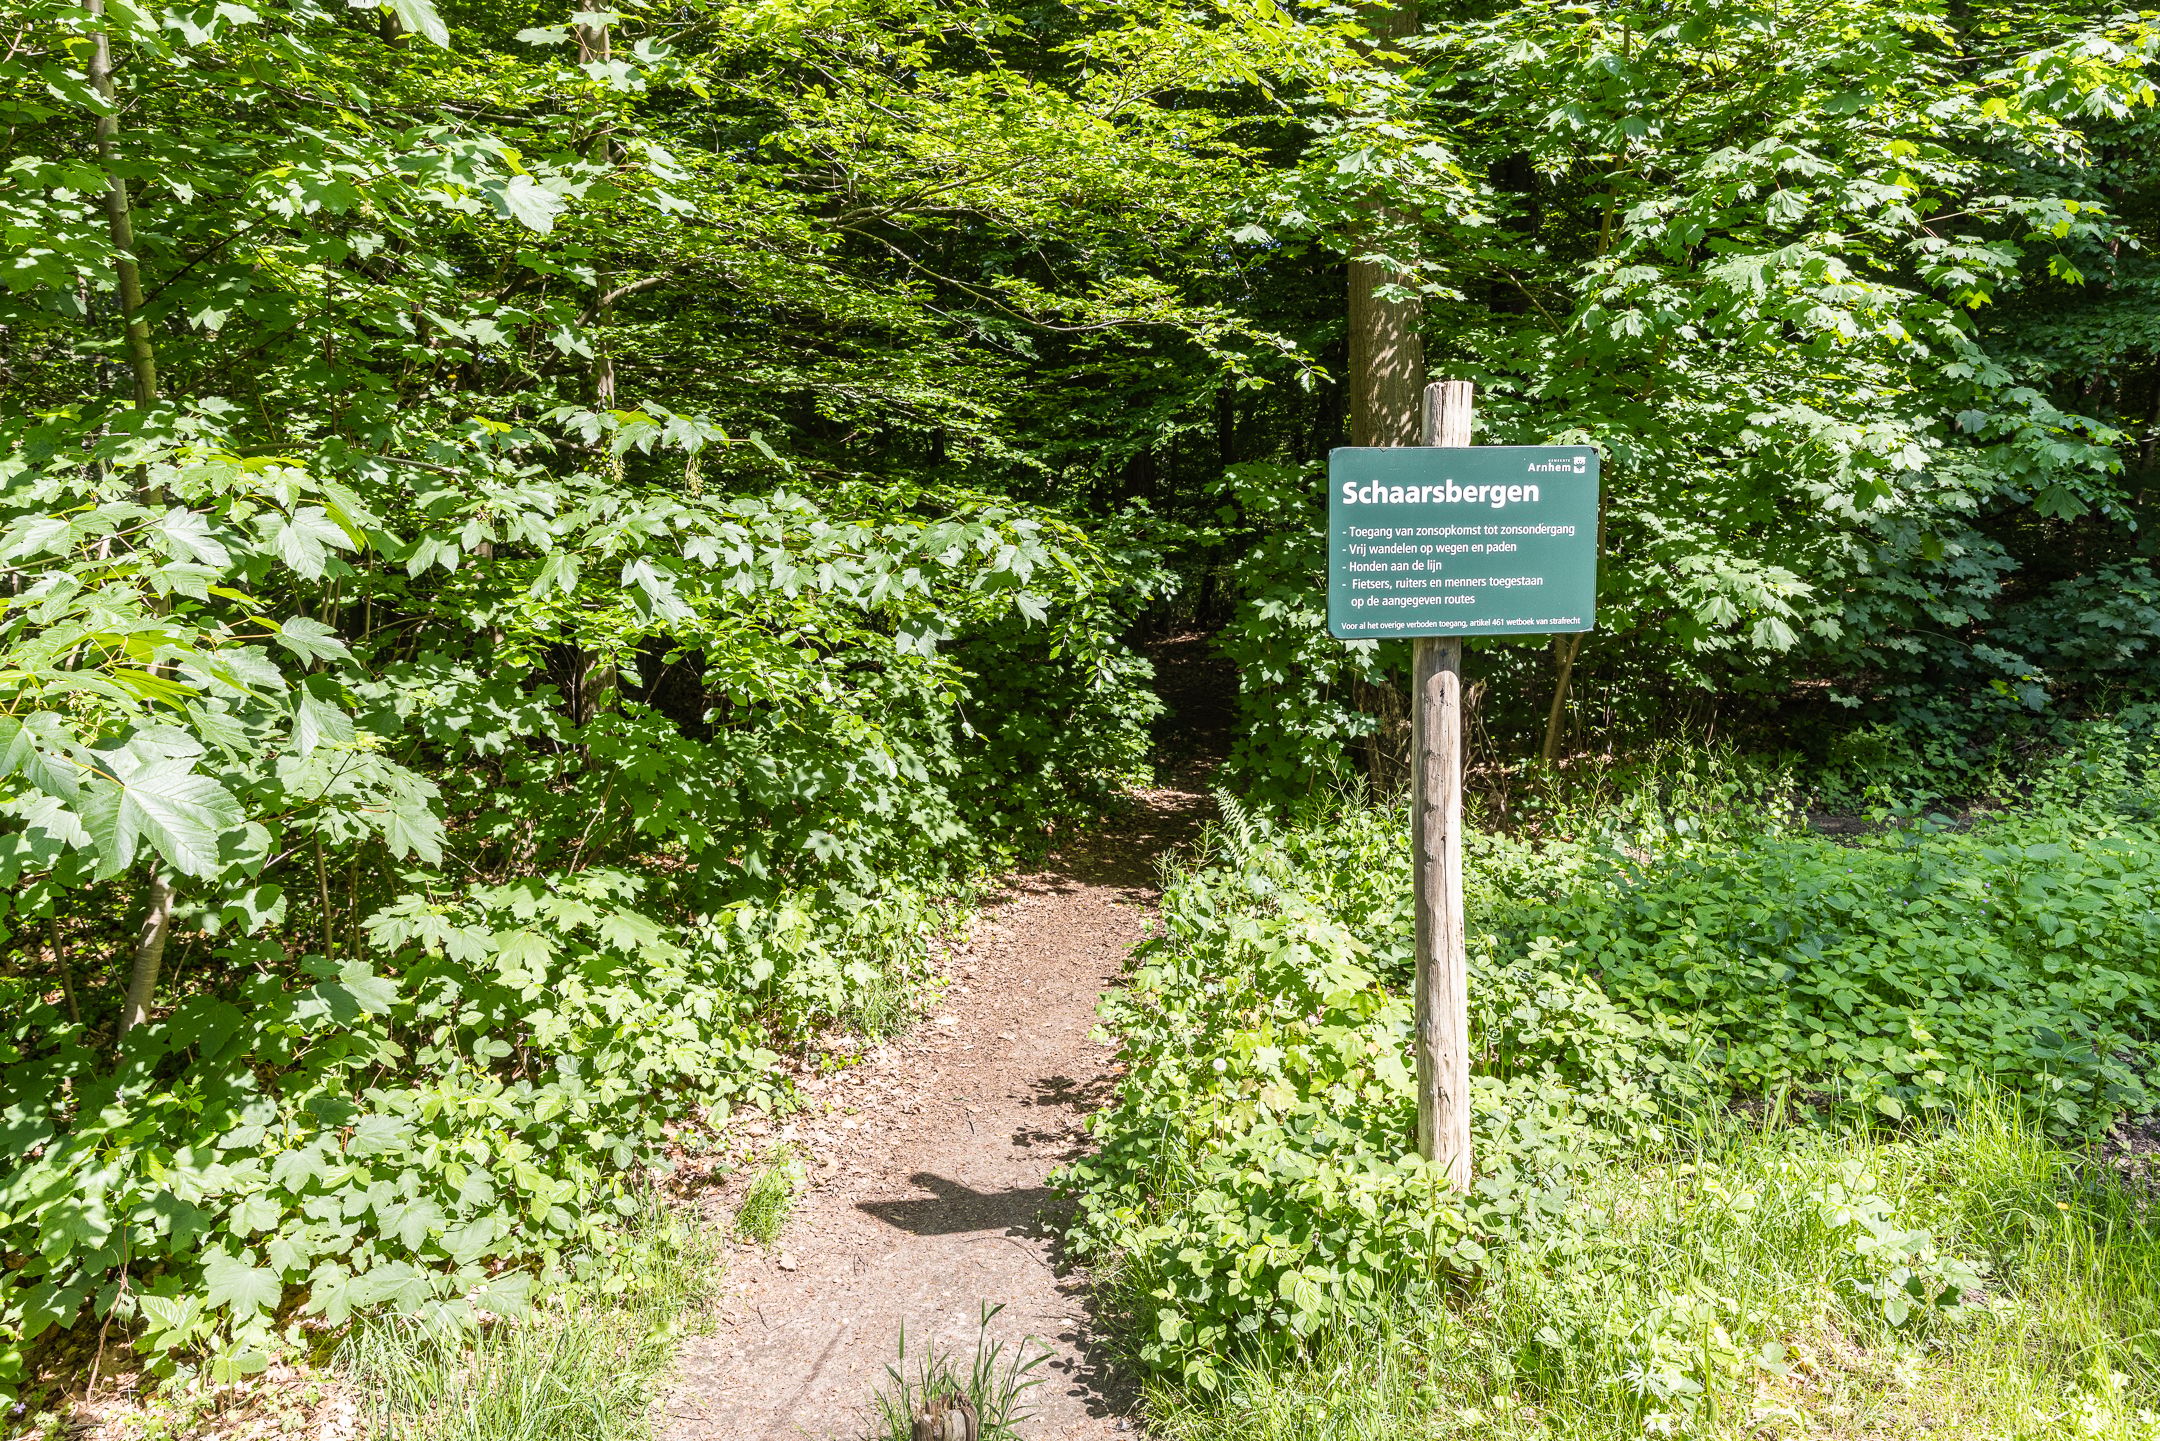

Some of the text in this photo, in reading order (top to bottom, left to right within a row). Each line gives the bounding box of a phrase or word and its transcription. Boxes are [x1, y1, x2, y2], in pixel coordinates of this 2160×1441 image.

[1528, 462, 1571, 471] Arnhem
[1343, 479, 1539, 508] Schaarsbergen
[1349, 527, 1392, 539] Toegang
[1395, 528, 1413, 536] van
[1416, 524, 1481, 538] zonsopkomst
[1484, 524, 1498, 535] tot
[1500, 522, 1576, 536] zonsondergang
[1349, 544, 1366, 557] Vrij
[1369, 543, 1417, 554] wandelen
[1420, 545, 1433, 555] op
[1436, 544, 1468, 555] wegen
[1471, 544, 1483, 552] en
[1486, 541, 1517, 553] paden
[1350, 561, 1387, 572] Honden
[1391, 563, 1409, 571] aan
[1412, 560, 1424, 570] de
[1427, 559, 1442, 573] lijn
[1353, 579, 1392, 589] Fietsers,
[1396, 578, 1427, 588] ruiters
[1430, 579, 1441, 587] en
[1445, 579, 1486, 587] menners
[1489, 576, 1543, 588] toegestaan
[1351, 595, 1475, 608] op de aangegeven routes
[1359, 622, 1365, 630] al
[1367, 622, 1378, 630] het
[1380, 621, 1405, 631] overige
[1406, 620, 1437, 629] verboden
[1439, 621, 1468, 630] toegang,
[1470, 619, 1490, 627] artikel
[1492, 618, 1504, 627] 461
[1506, 618, 1534, 626] wetboek
[1549, 616, 1580, 625] strafrecht
